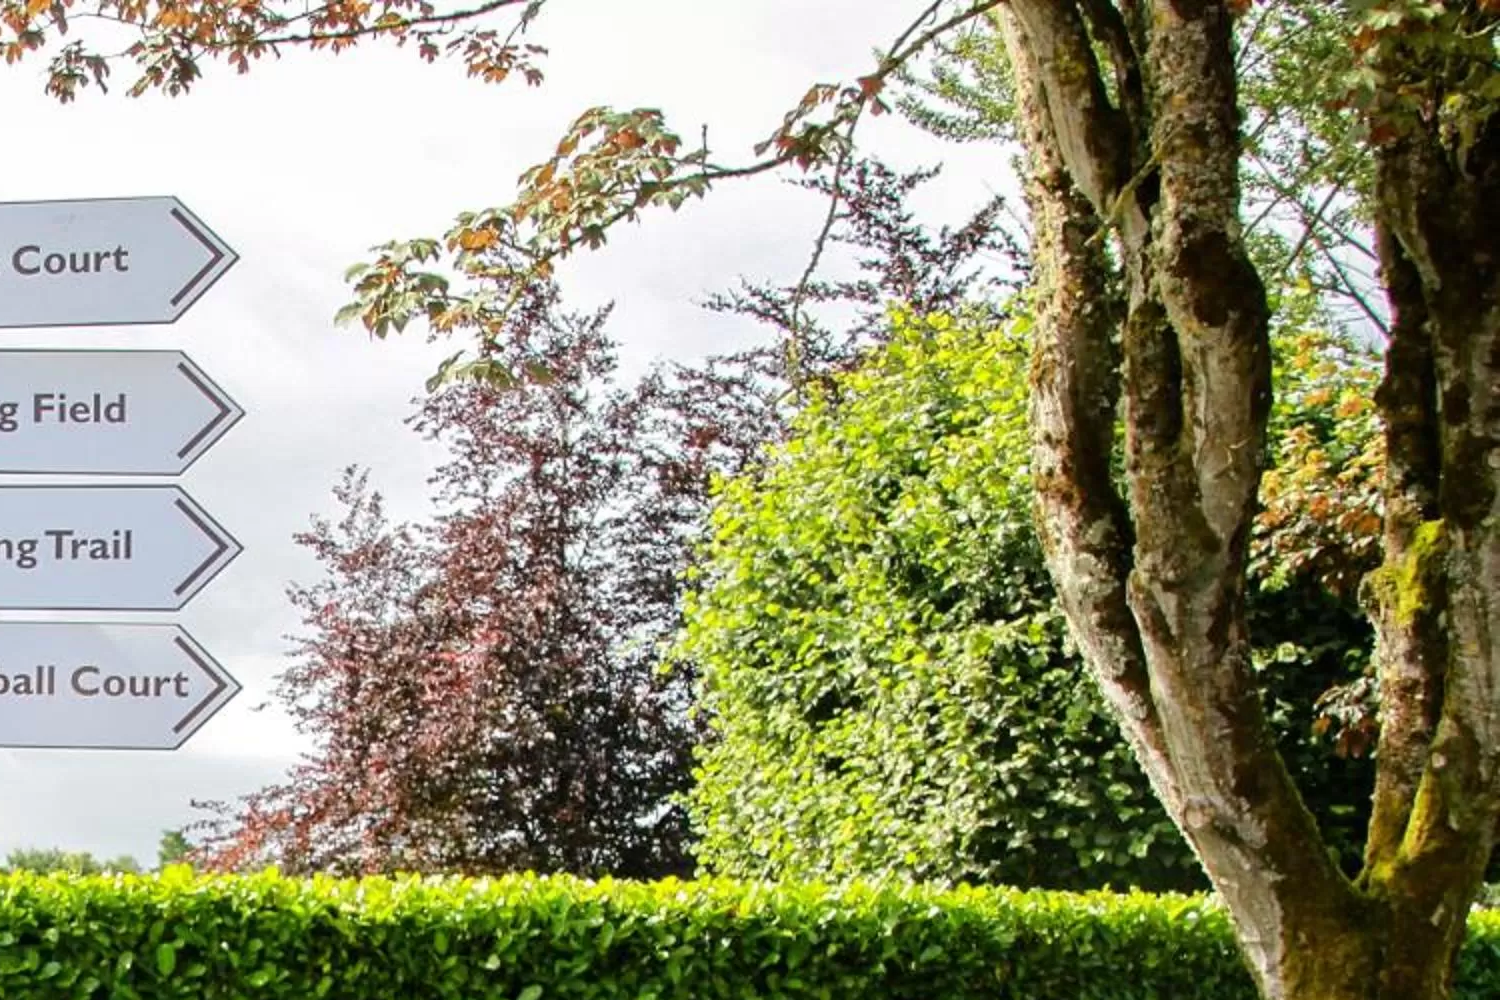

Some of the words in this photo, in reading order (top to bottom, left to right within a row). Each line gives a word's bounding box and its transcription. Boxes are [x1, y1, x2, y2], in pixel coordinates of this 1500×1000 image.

[12, 245, 129, 276] Court
[33, 393, 127, 423] Field
[45, 529, 132, 560] Trail
[71, 665, 189, 697] Court
